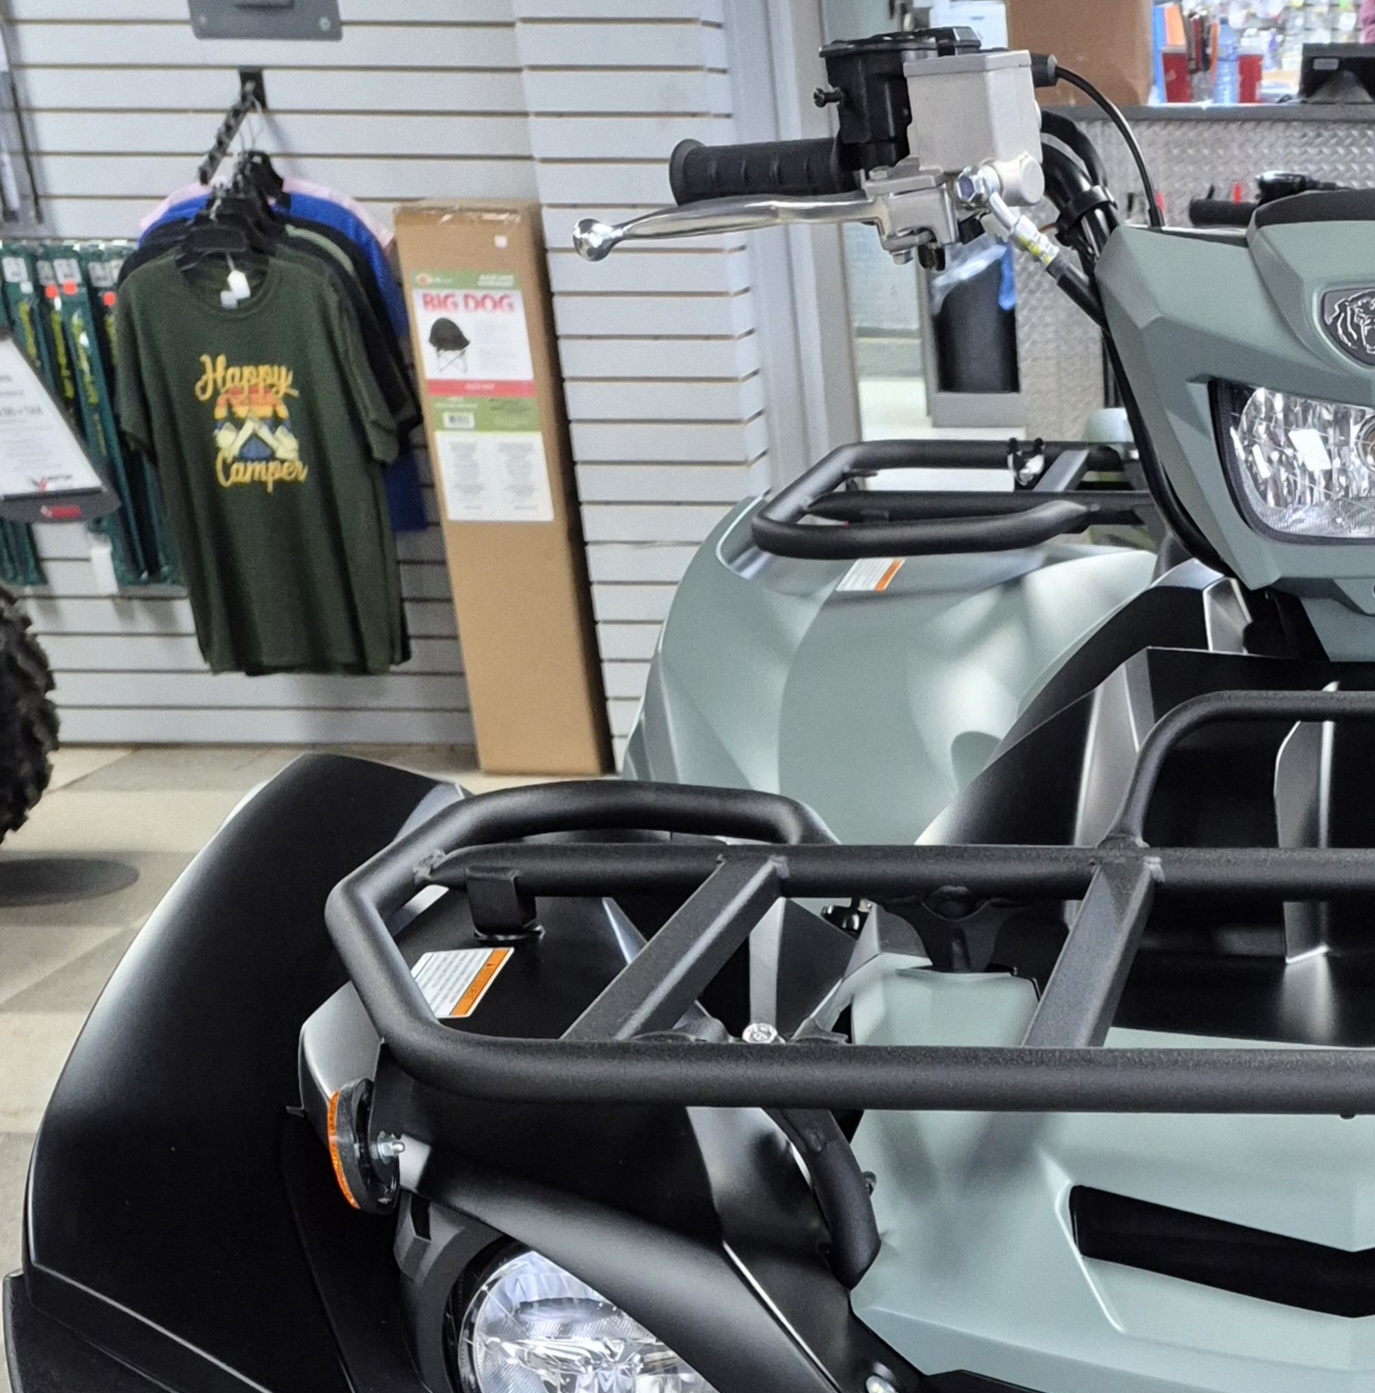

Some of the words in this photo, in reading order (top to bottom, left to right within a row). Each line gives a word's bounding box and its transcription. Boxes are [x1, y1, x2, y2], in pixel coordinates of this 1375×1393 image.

[422, 292, 459, 313] BIG
[463, 292, 516, 314] DOG
[194, 353, 299, 401] Happy
[215, 448, 308, 493] Camper
